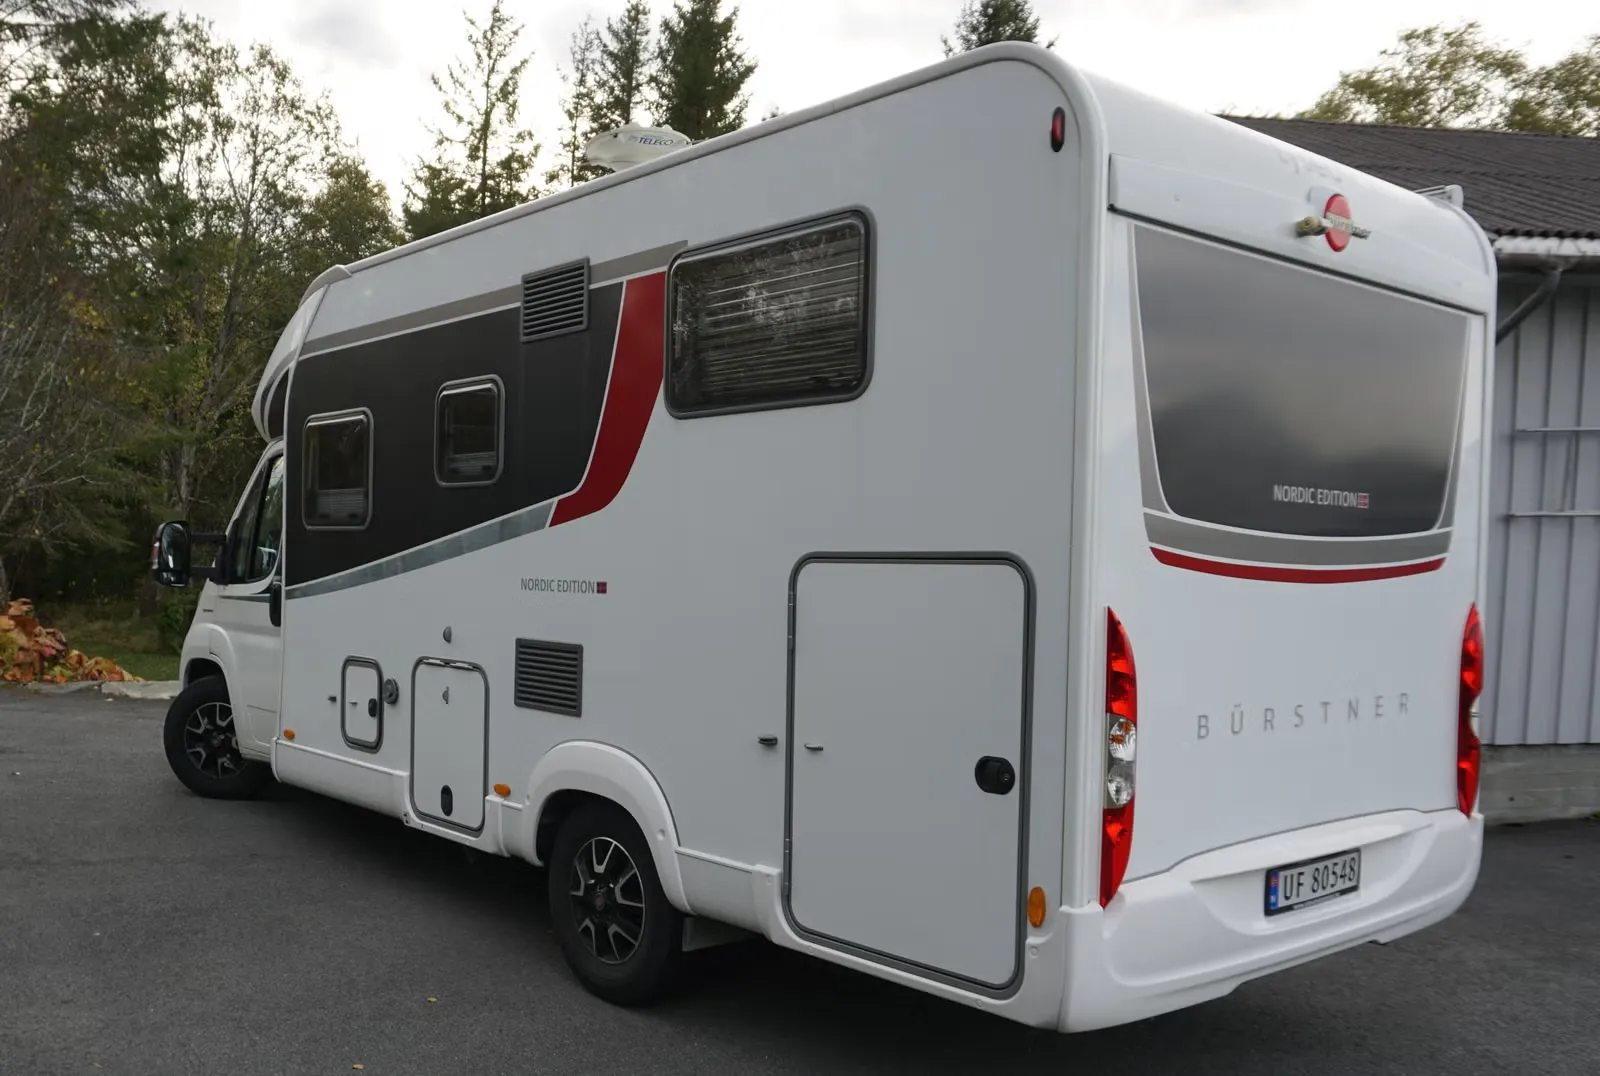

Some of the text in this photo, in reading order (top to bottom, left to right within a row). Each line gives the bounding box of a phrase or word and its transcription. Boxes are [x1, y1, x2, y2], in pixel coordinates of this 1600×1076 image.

[639, 137, 674, 146] TELECO
[1273, 484, 1357, 508] NORDIC EDITION
[520, 578, 595, 595] NORDIC EDITION
[1197, 692, 1409, 740] BÜRSTNER
[1283, 871, 1305, 901] UF
[1311, 856, 1356, 893] 80548
